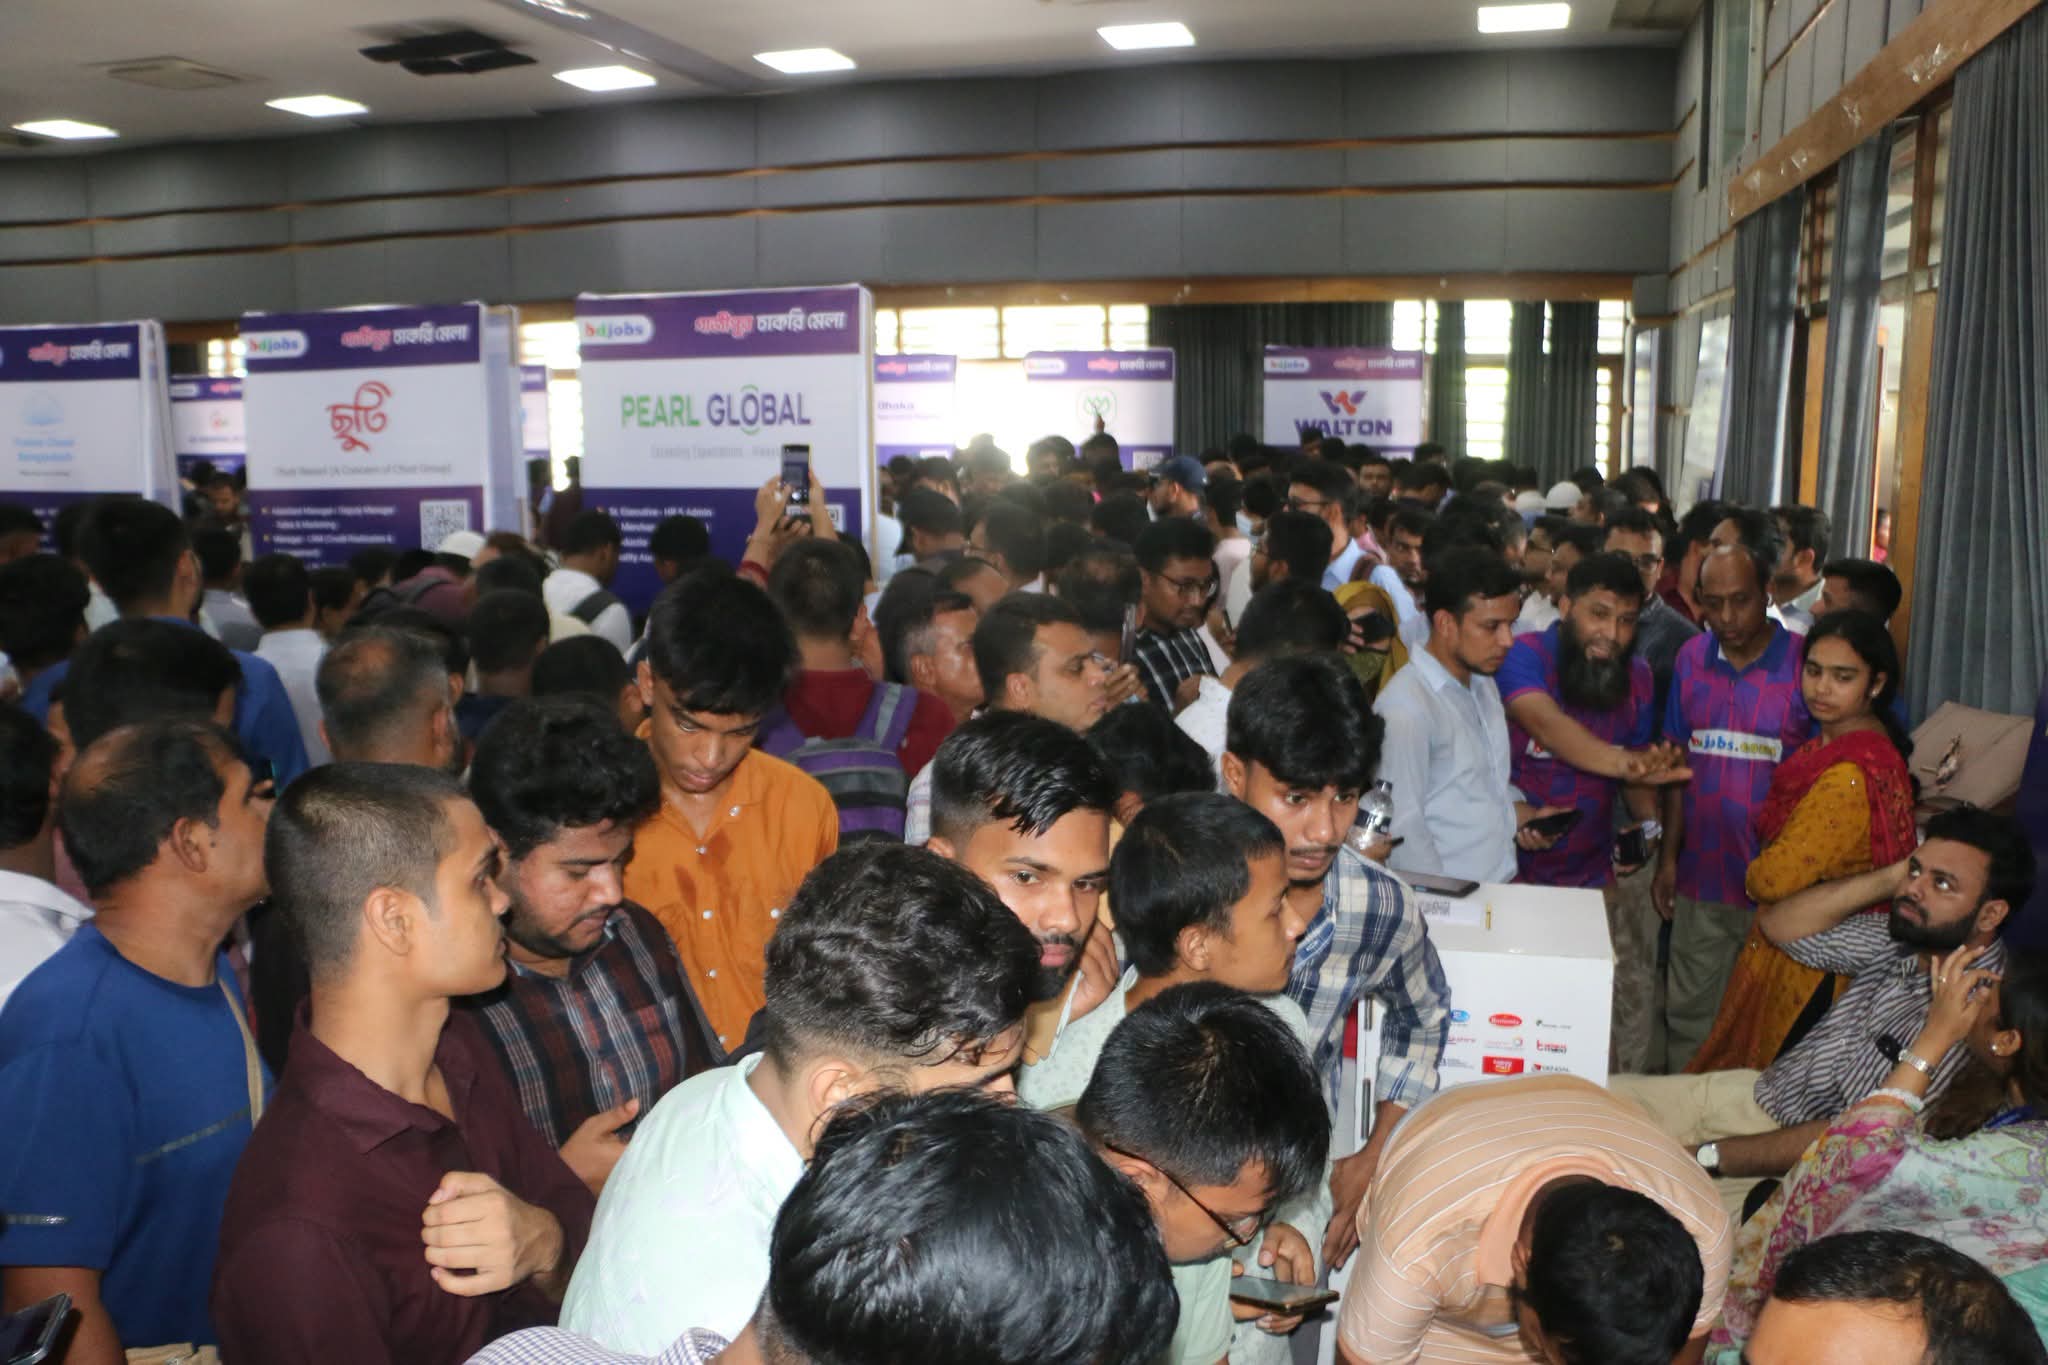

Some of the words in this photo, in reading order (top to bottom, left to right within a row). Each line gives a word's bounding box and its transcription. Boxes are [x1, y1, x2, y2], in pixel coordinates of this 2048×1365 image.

[756, 307, 803, 332] চাকরি
[808, 311, 846, 330] মেলা
[585, 322, 643, 339] bdjobs
[249, 338, 298, 355] bdjobs
[621, 394, 700, 427] PEARL
[707, 392, 811, 427] GLOBAL
[1294, 419, 1393, 436] WALTON
